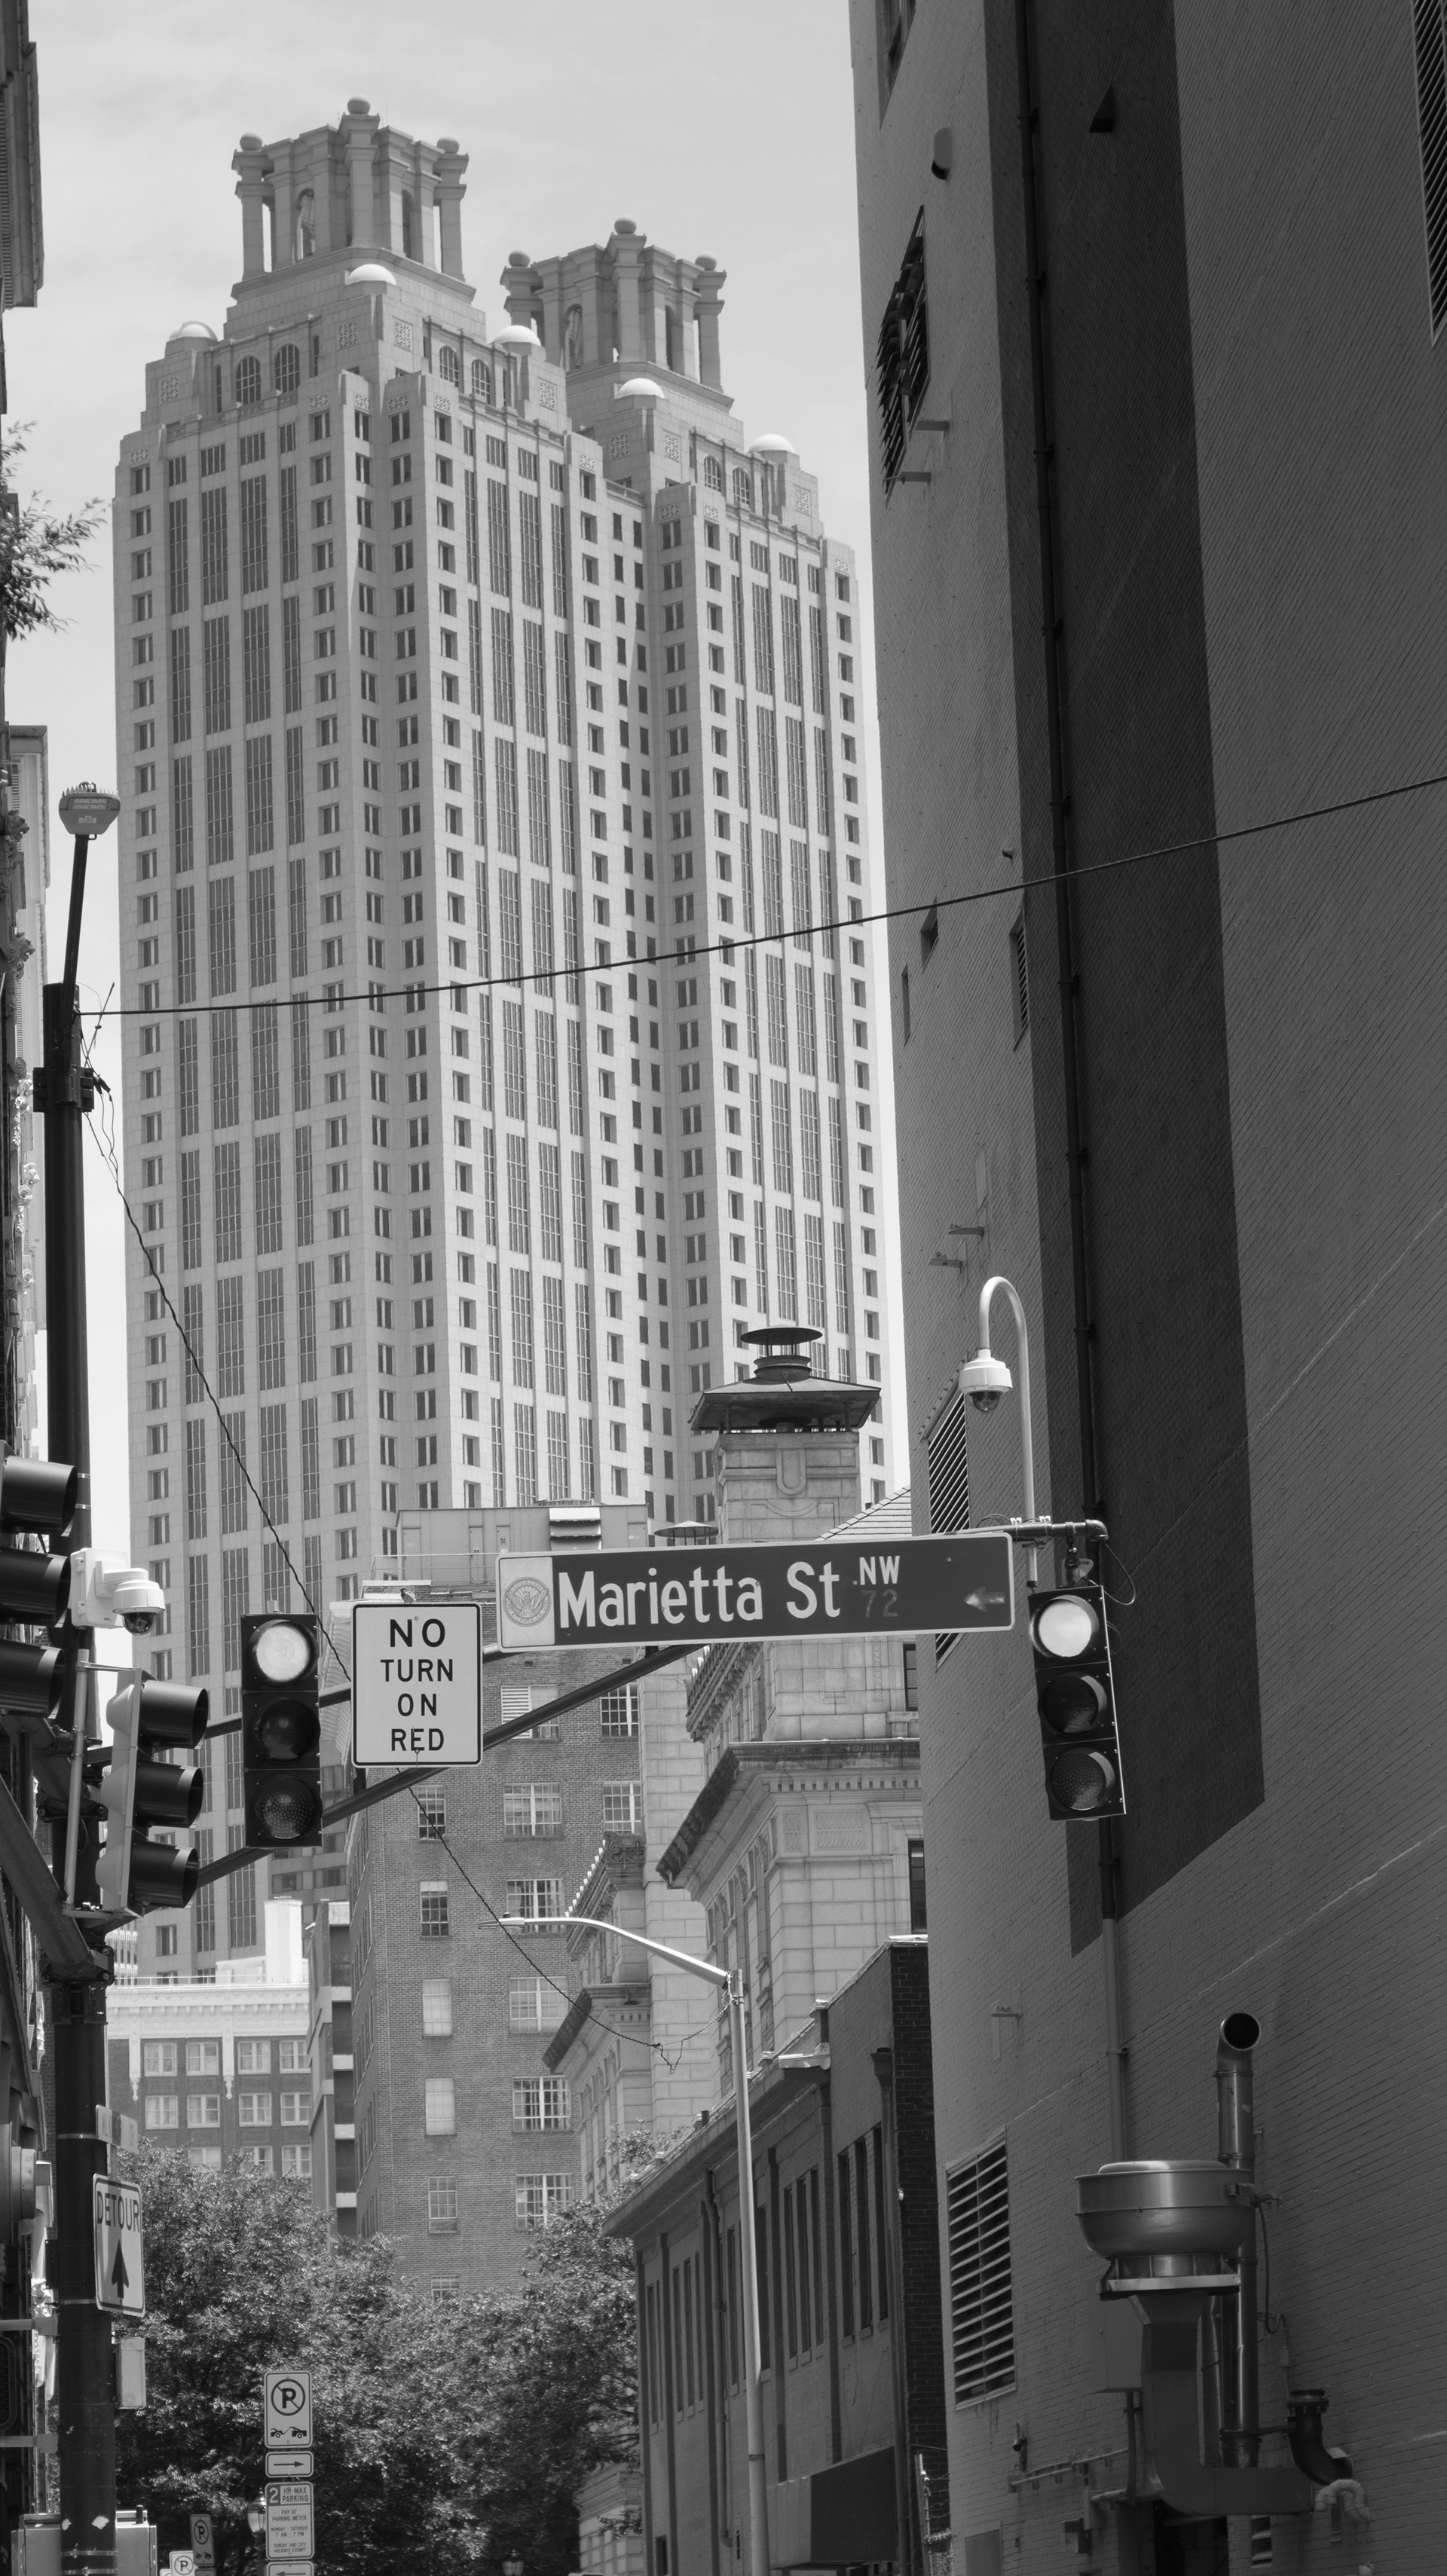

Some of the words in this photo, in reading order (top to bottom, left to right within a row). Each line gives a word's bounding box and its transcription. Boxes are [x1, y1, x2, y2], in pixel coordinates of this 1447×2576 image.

[558, 1566, 763, 1629] Marietta
[786, 1560, 841, 1619] St
[858, 1555, 901, 1586] NW
[861, 1589, 899, 1618] 72
[390, 1618, 445, 1648] NO
[380, 1658, 453, 1682] TURN
[397, 1693, 437, 1717] ON
[391, 1728, 444, 1752] RED
[96, 2190, 140, 2233] DETOUR
[269, 2487, 278, 2504] 2
[282, 2495, 309, 2503] PARKING
